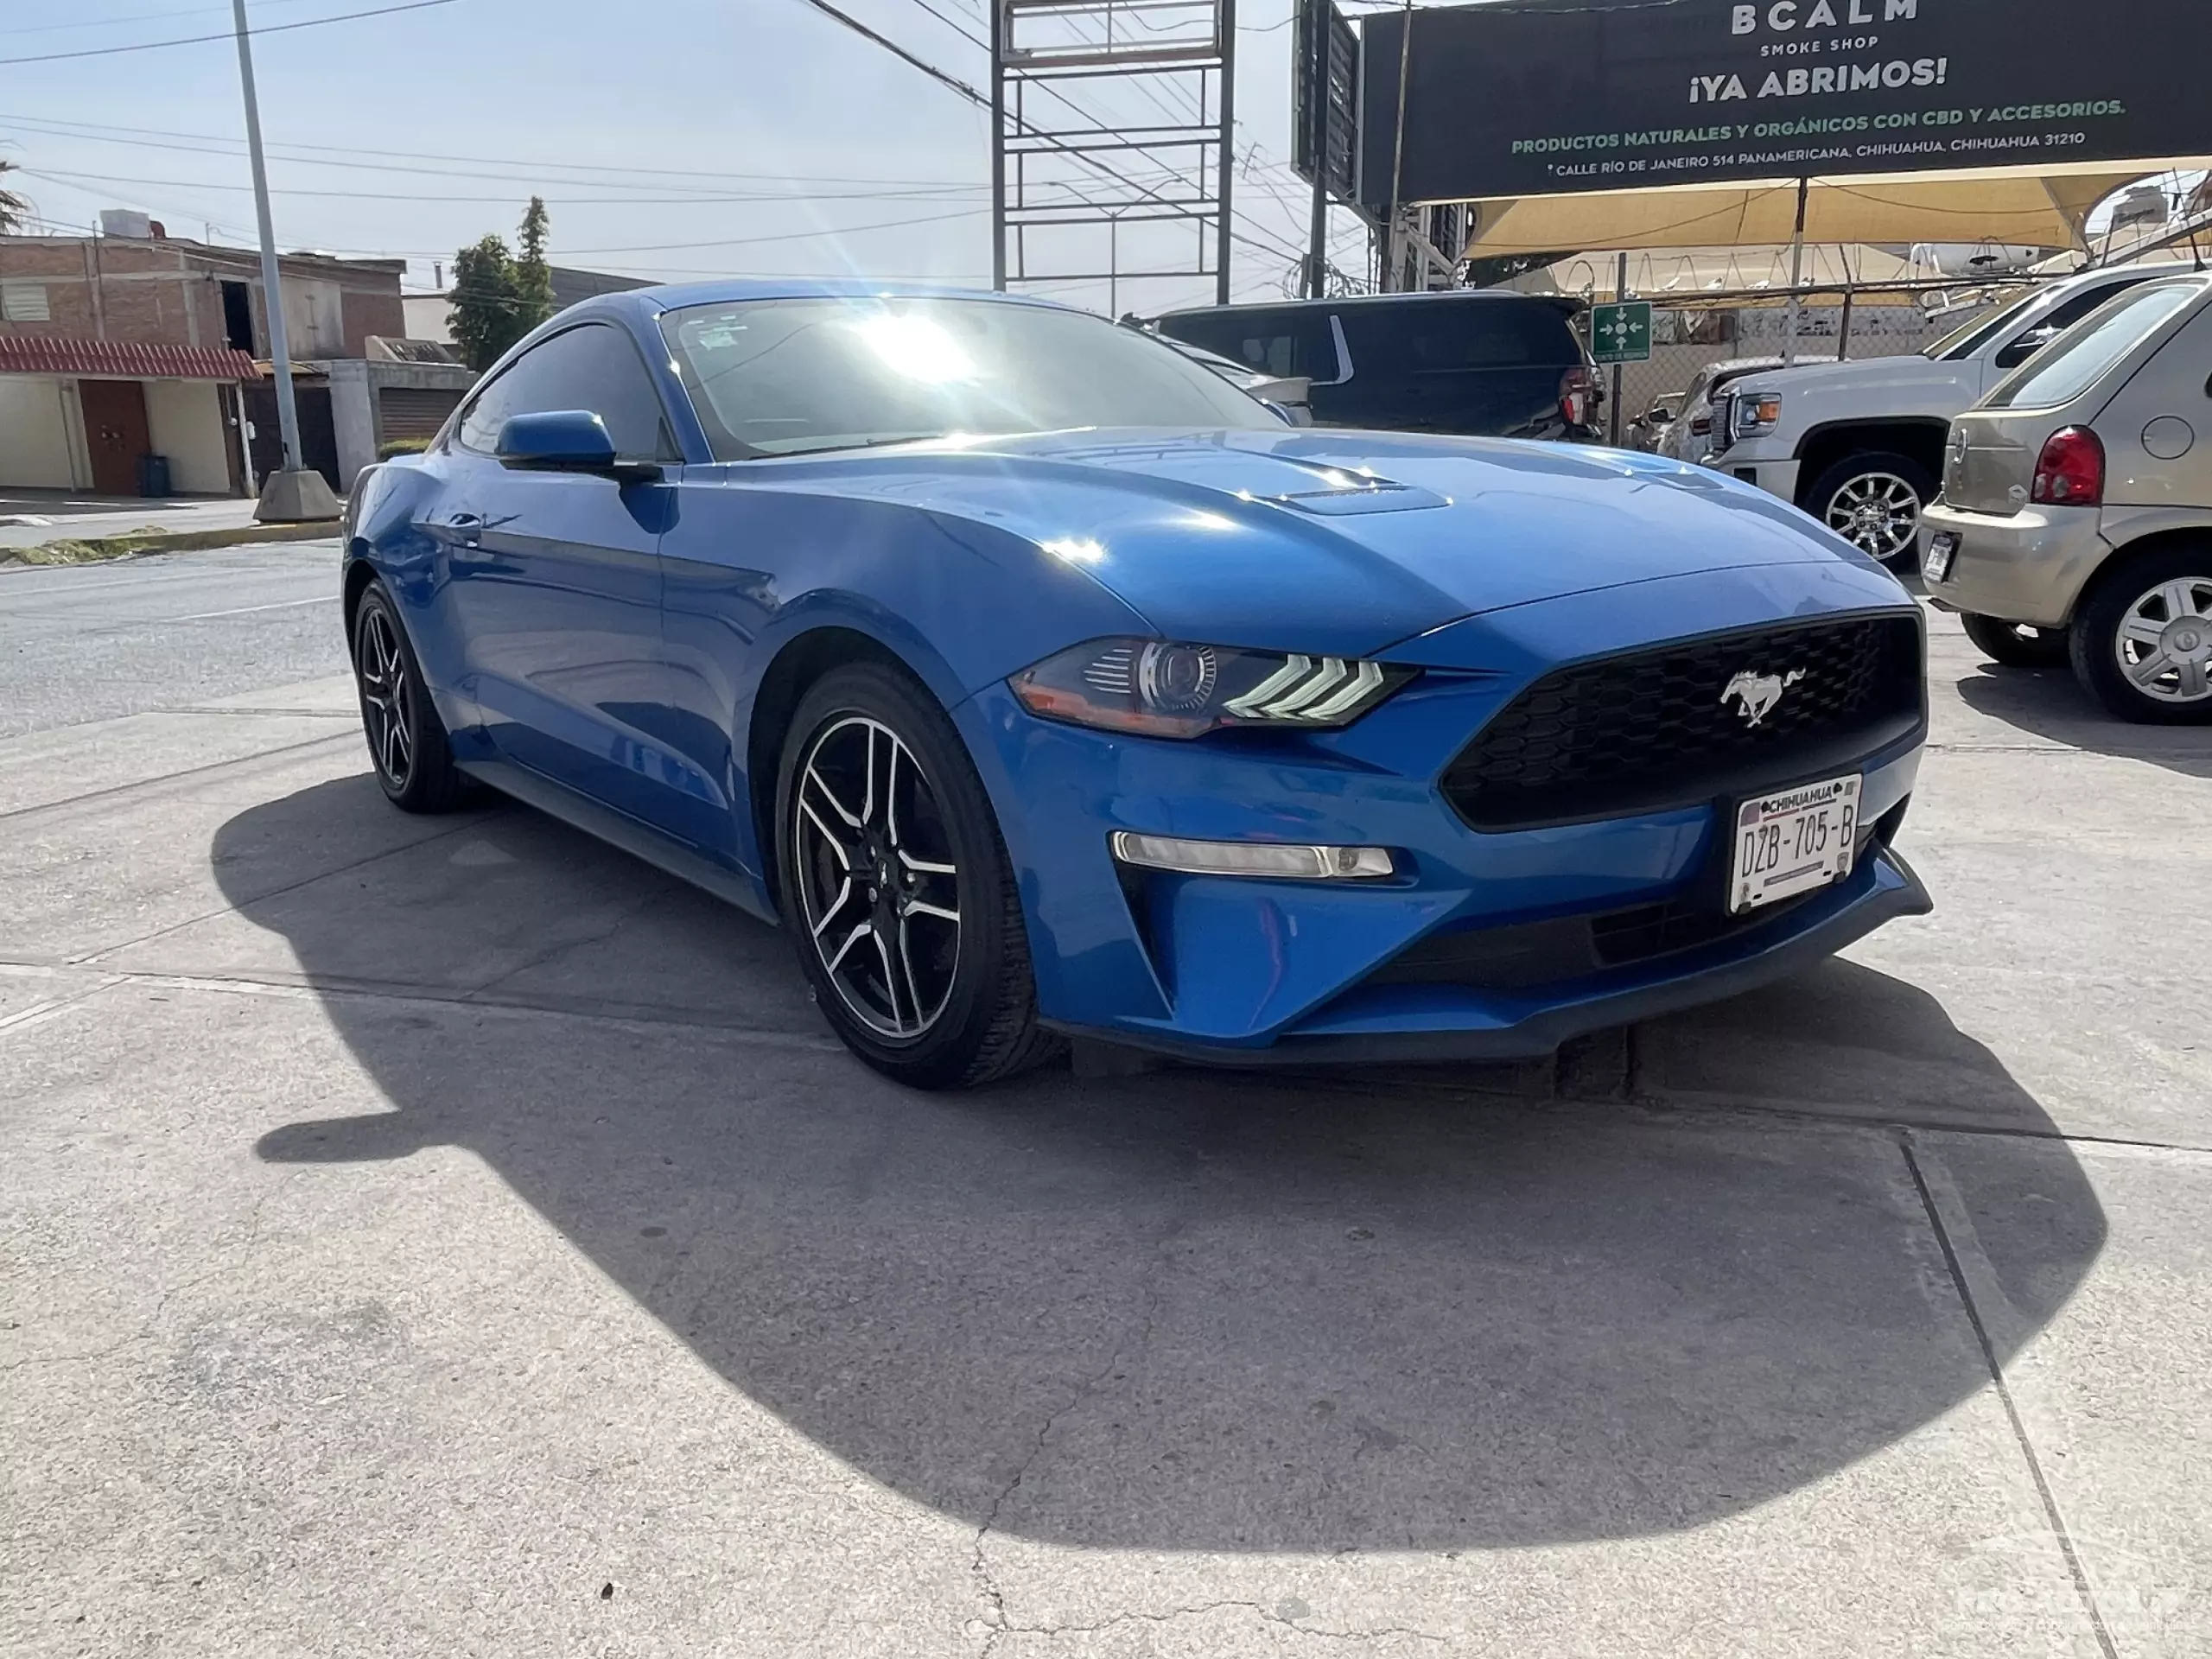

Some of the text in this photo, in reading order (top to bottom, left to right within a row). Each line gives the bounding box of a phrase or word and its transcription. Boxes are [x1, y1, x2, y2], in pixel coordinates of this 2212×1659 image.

[1732, 0, 1917, 35] BCALM
[1760, 36, 1878, 56] SMOKE SHOP
[1689, 57, 1948, 103] ¡YA ABRIMOS!
[1512, 99, 2126, 153] PRODUCTOS NATURALES Y ORGÁNICOS CON CBD Y ACCESORIOS.
[1556, 132, 2085, 176] CALLE RÍO DE JANEIRO 514 PANAMERICANA, CHIHUAHUA, CHIHUAHUA 31210
[1770, 785, 1832, 813] CHIHUAHUA
[1742, 804, 1853, 878] DZB-705-B
